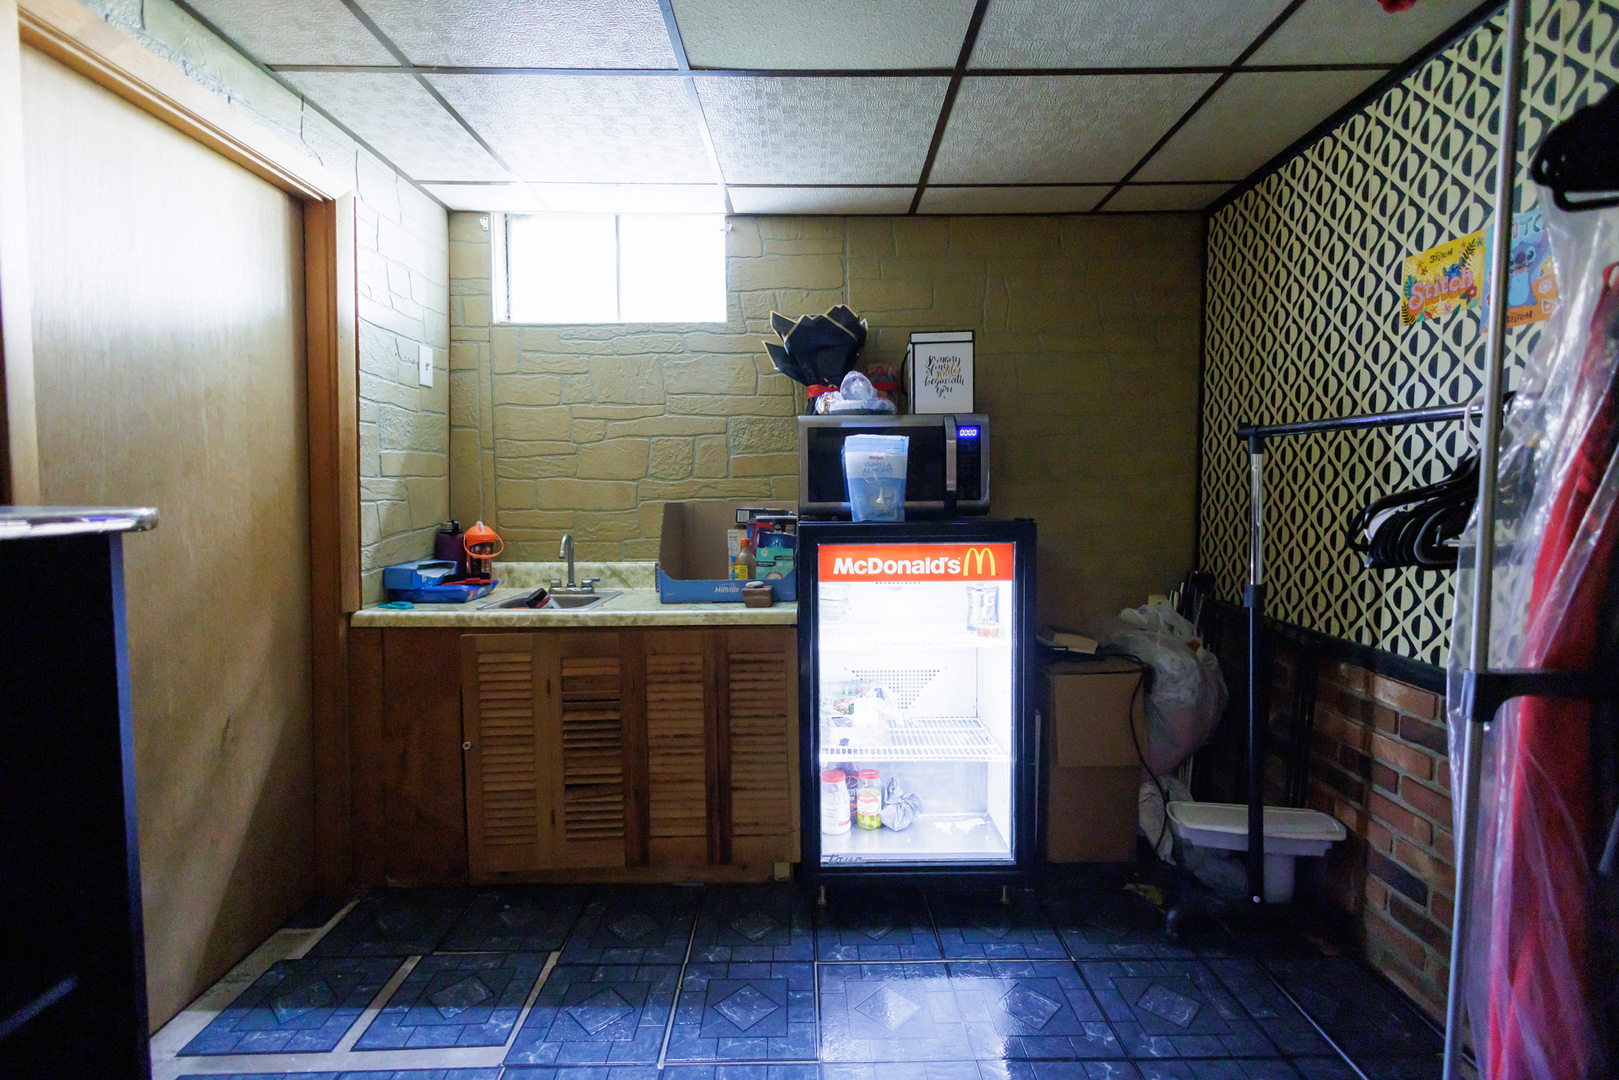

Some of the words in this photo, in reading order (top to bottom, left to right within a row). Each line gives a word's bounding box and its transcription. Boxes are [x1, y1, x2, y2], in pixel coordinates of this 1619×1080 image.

[1429, 247, 1453, 264] STITCH
[1408, 266, 1474, 313] Stitch
[937, 355, 961, 367] many
[924, 374, 947, 388] begin
[935, 385, 953, 398] you
[833, 557, 961, 575] McDonald's
[714, 586, 740, 594] Millville
